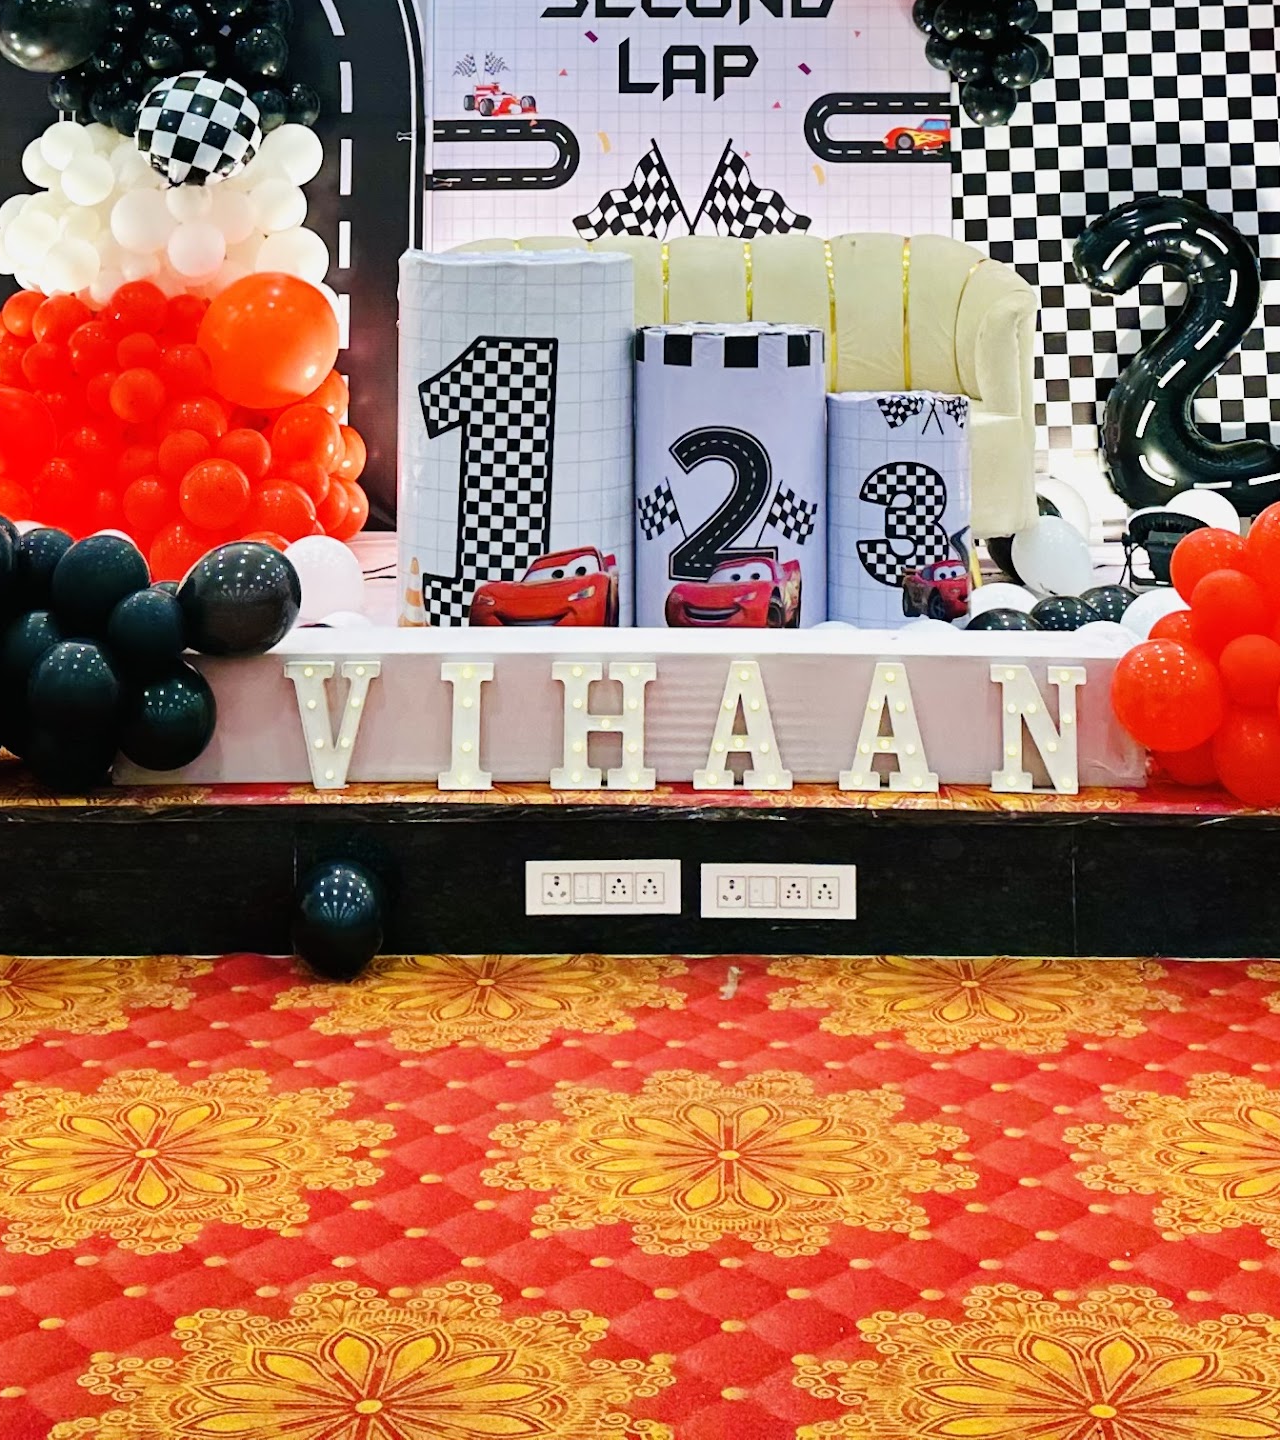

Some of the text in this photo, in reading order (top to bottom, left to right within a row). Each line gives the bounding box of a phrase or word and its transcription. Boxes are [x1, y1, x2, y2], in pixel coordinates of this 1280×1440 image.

[617, 37, 760, 102] LAP
[418, 336, 558, 627] 1
[668, 426, 779, 581] 2
[856, 461, 948, 587] 3
[284, 661, 1087, 795] VIHAAN
